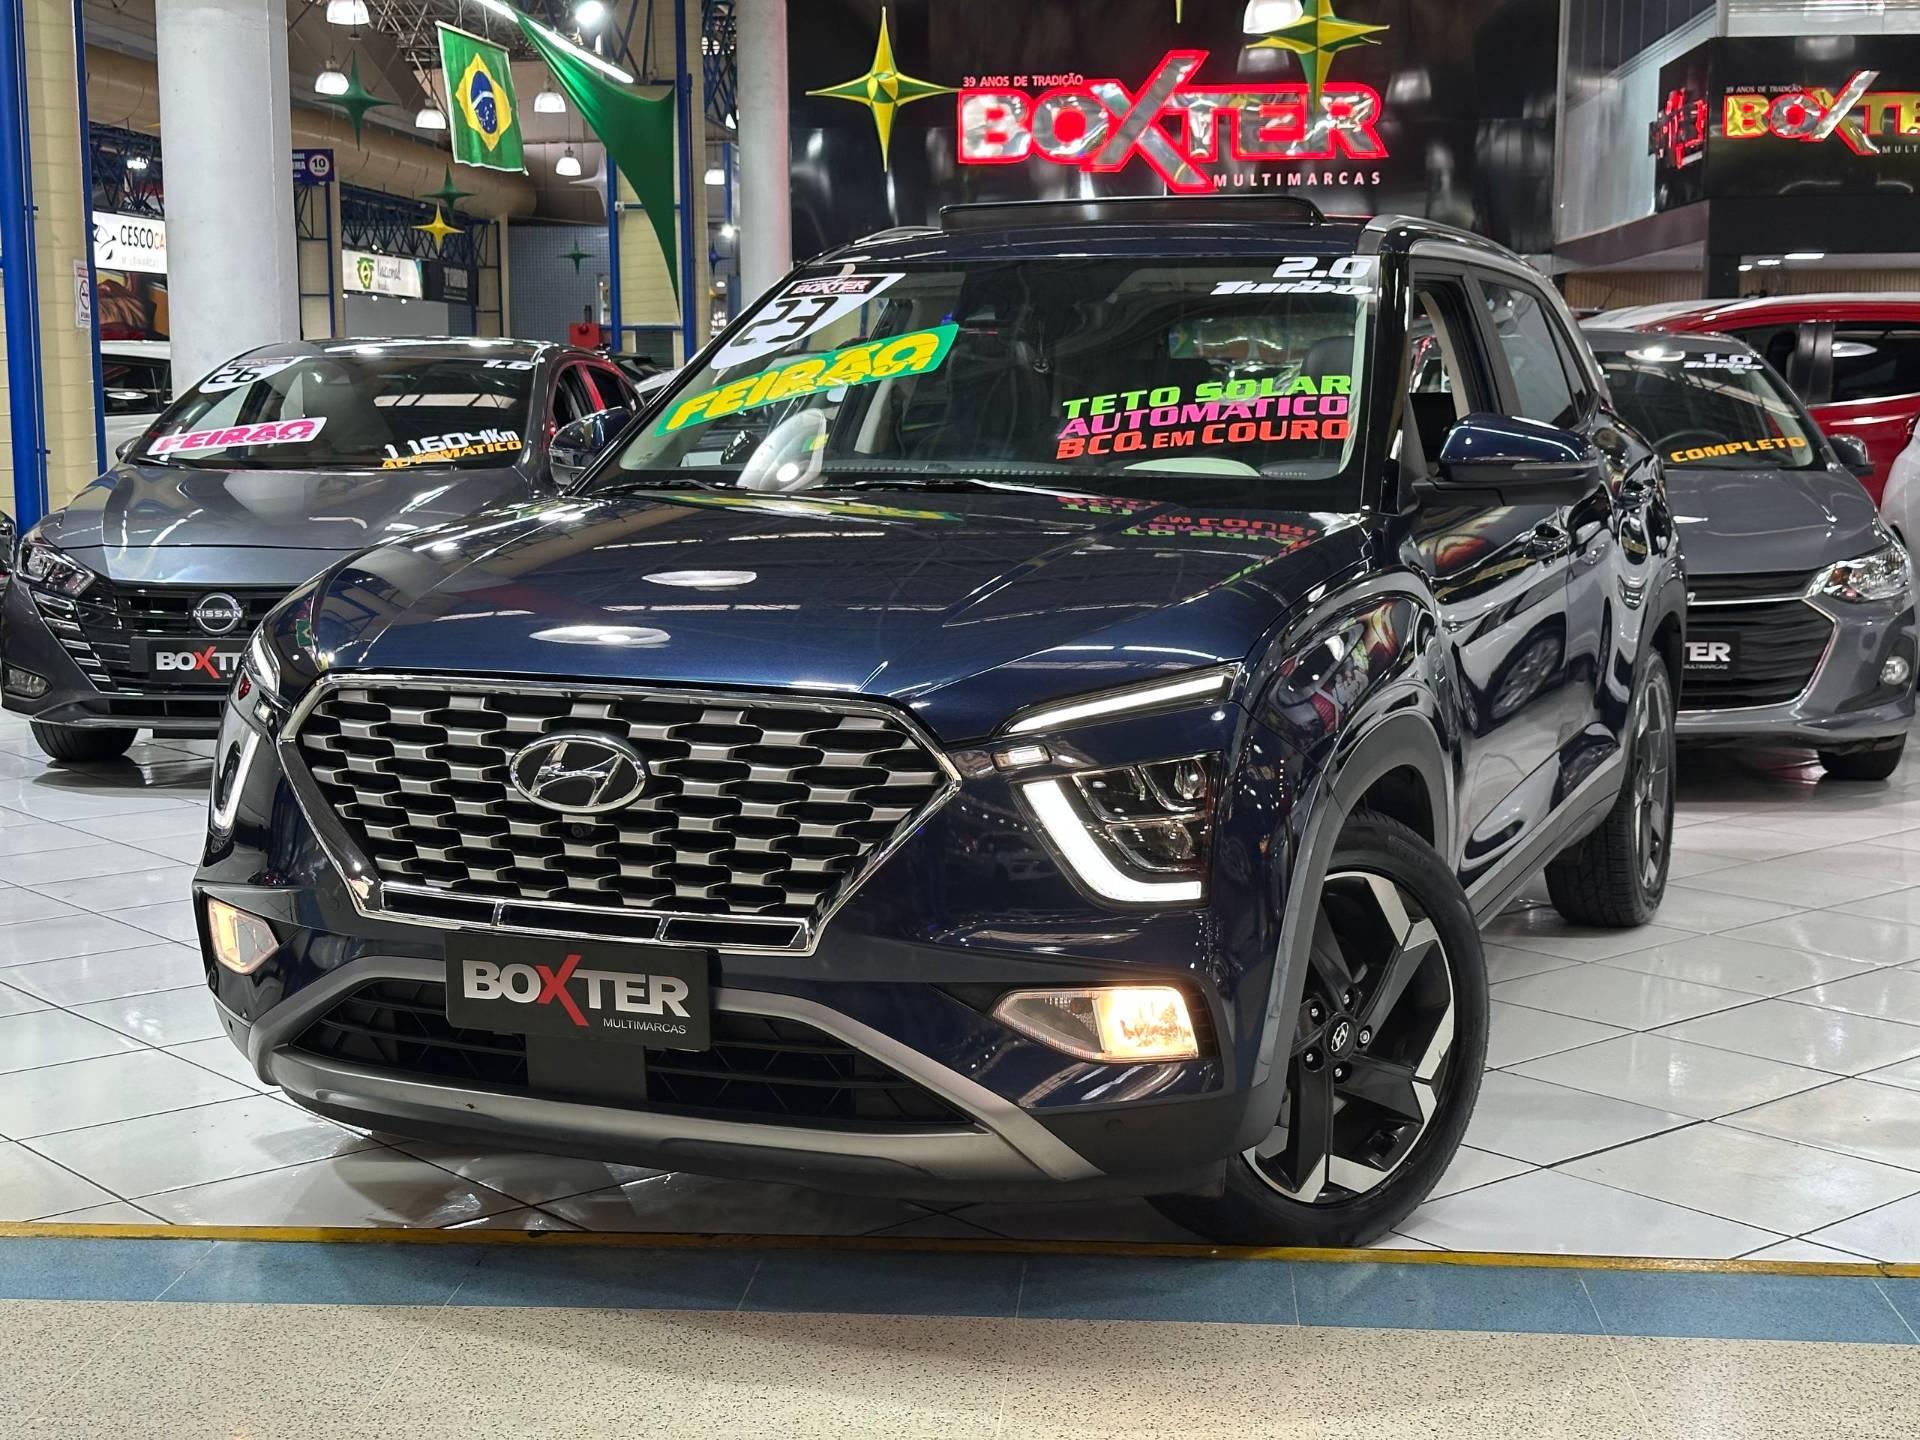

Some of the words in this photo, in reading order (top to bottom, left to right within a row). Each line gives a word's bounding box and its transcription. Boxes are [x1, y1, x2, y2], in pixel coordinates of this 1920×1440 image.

[962, 76, 976, 88] 39
[980, 75, 1010, 88] ANOS
[1013, 76, 1028, 87] DE
[1032, 72, 1084, 88] TRADIÇÃO
[1769, 83, 1802, 93] TRADIÇÃO
[957, 49, 1389, 193] BOXTER
[312, 158, 326, 168] 10
[1213, 171, 1382, 188] MULTIMARCAS
[1273, 256, 1372, 278] 2.0
[1210, 281, 1373, 295] Turbo
[729, 296, 840, 348] 23
[483, 359, 533, 370] 1.6
[1703, 352, 1752, 364] 1.0
[207, 366, 263, 384] 26
[1062, 386, 1181, 419] TETO
[1195, 375, 1351, 403] SOLAR
[1057, 396, 1348, 440] AUTOMATICO
[1152, 430, 1195, 449] EM
[1202, 418, 1350, 445] COURO
[382, 440, 522, 469] AUTOMATICO
[1670, 436, 1806, 462] COMPLETO
[192, 608, 243, 619] NISSAN
[462, 954, 691, 1027] BOXTER
[603, 1017, 687, 1035] MULTIMARCAS
